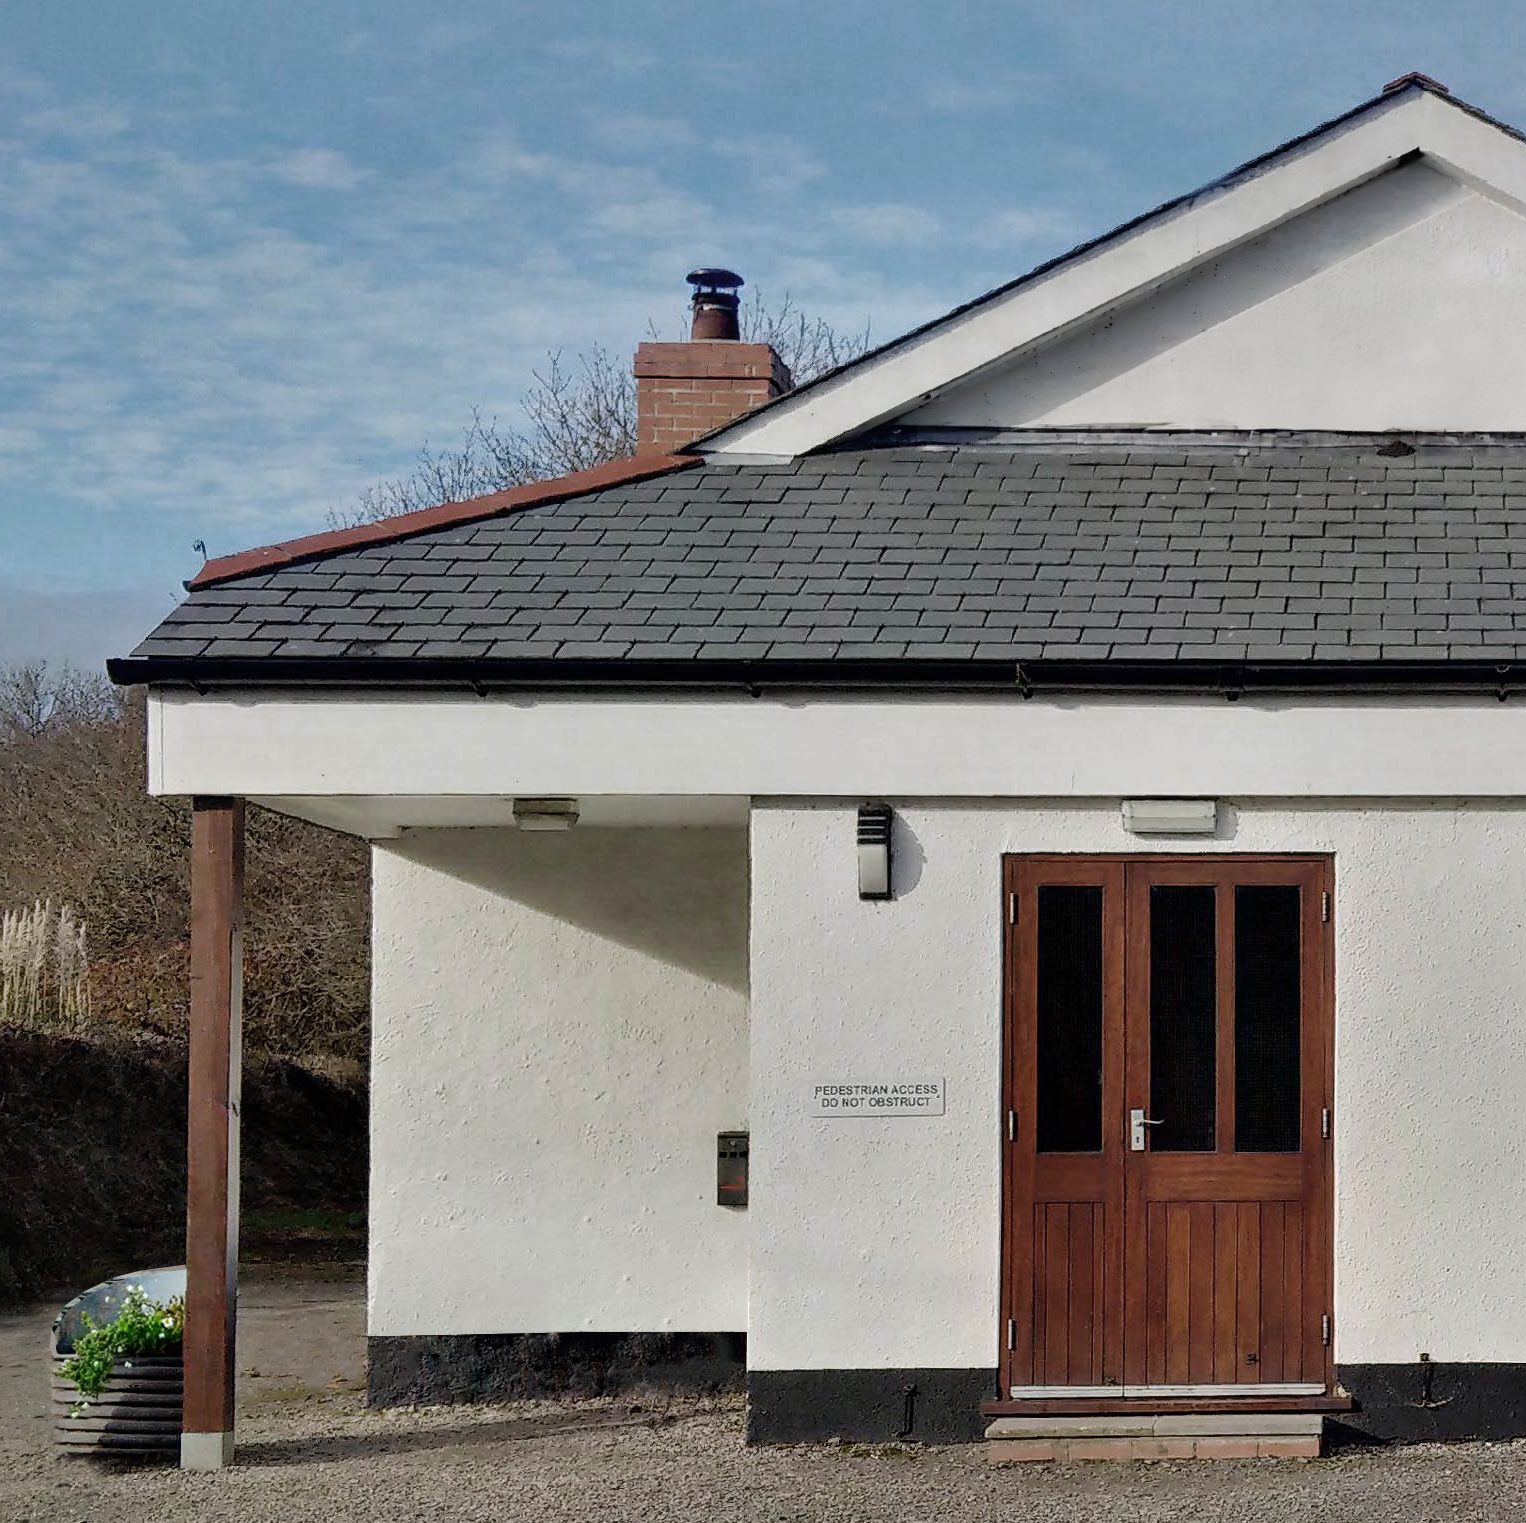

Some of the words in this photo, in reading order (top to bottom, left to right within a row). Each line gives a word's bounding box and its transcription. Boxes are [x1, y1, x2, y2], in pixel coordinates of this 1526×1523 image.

[815, 1085, 888, 1096] PEDESTRIAN
[891, 1084, 938, 1095] ACCESS
[822, 1098, 839, 1108] DO
[842, 1097, 866, 1107] NOT
[869, 1097, 931, 1107] OBSTRUCT
